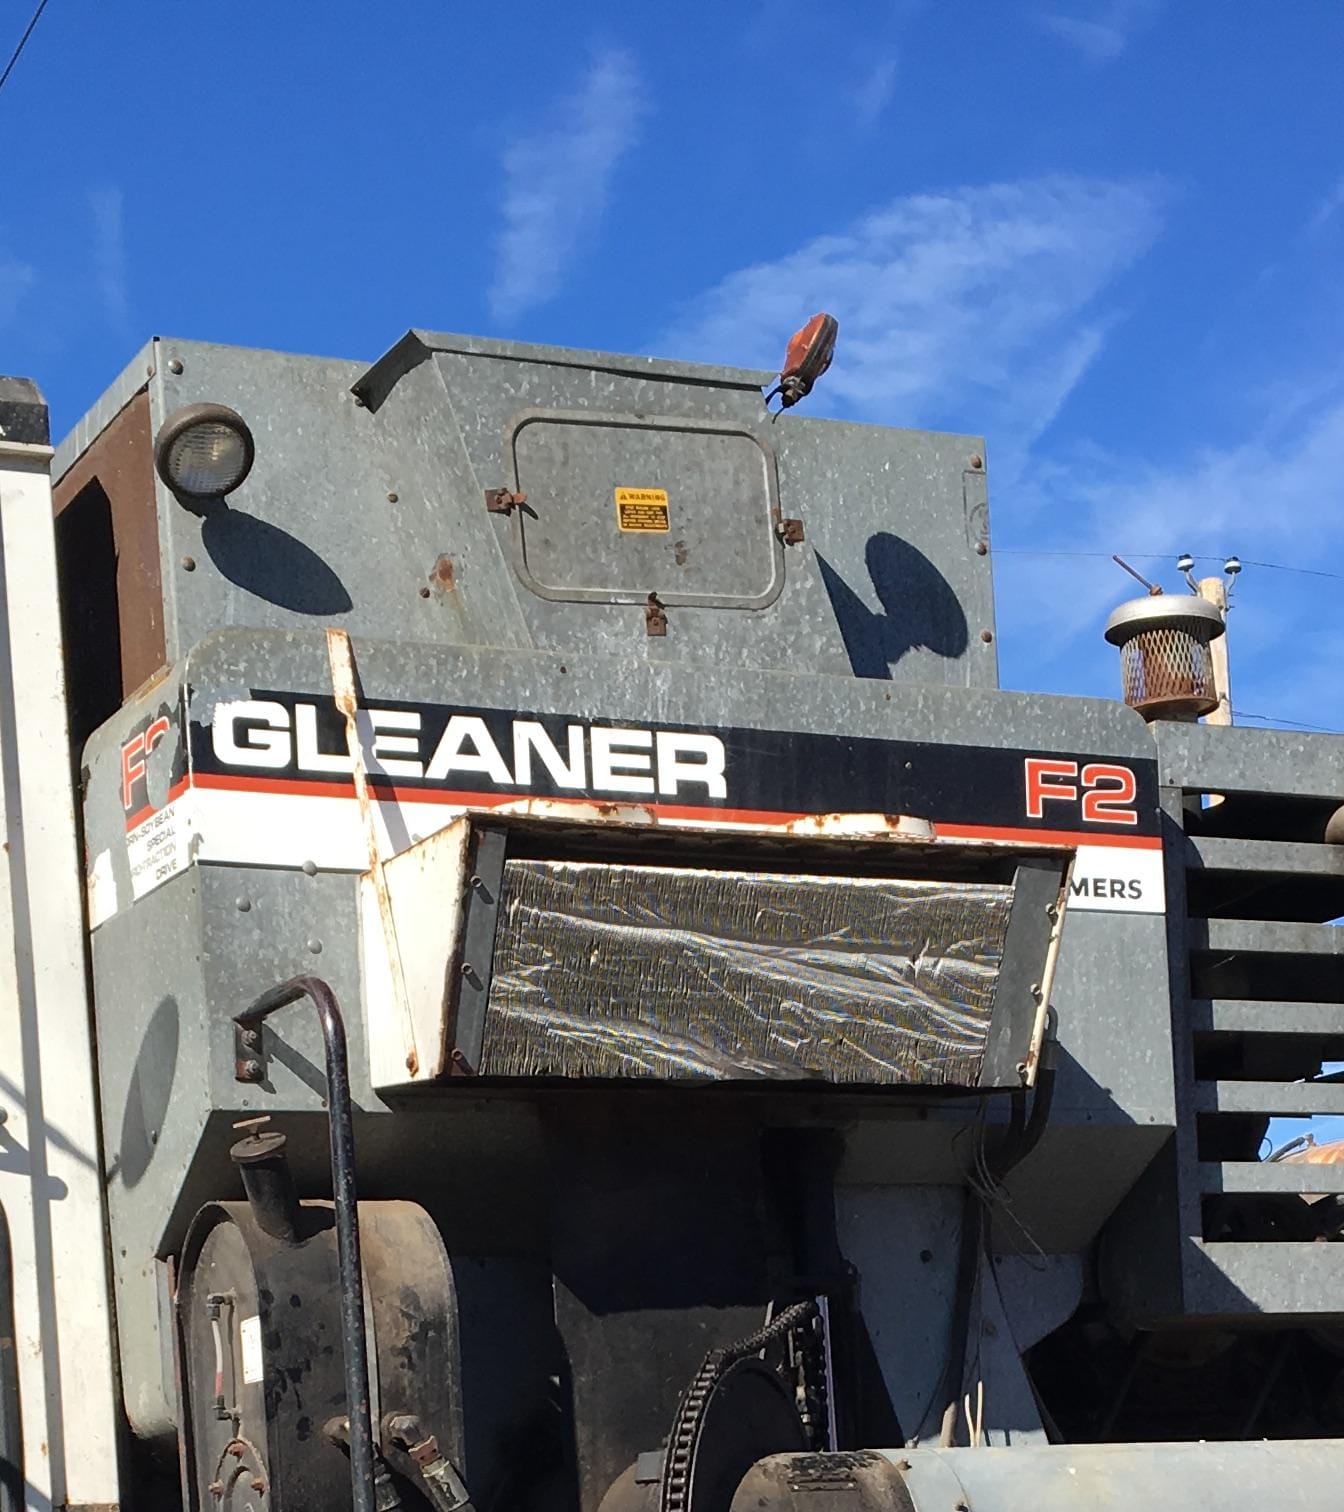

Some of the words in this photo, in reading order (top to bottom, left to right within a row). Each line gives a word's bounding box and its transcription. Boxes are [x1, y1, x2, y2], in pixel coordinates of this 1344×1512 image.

[628, 492, 667, 501] WARNING
[212, 700, 728, 799] GLEANER
[1024, 757, 1138, 825] F2
